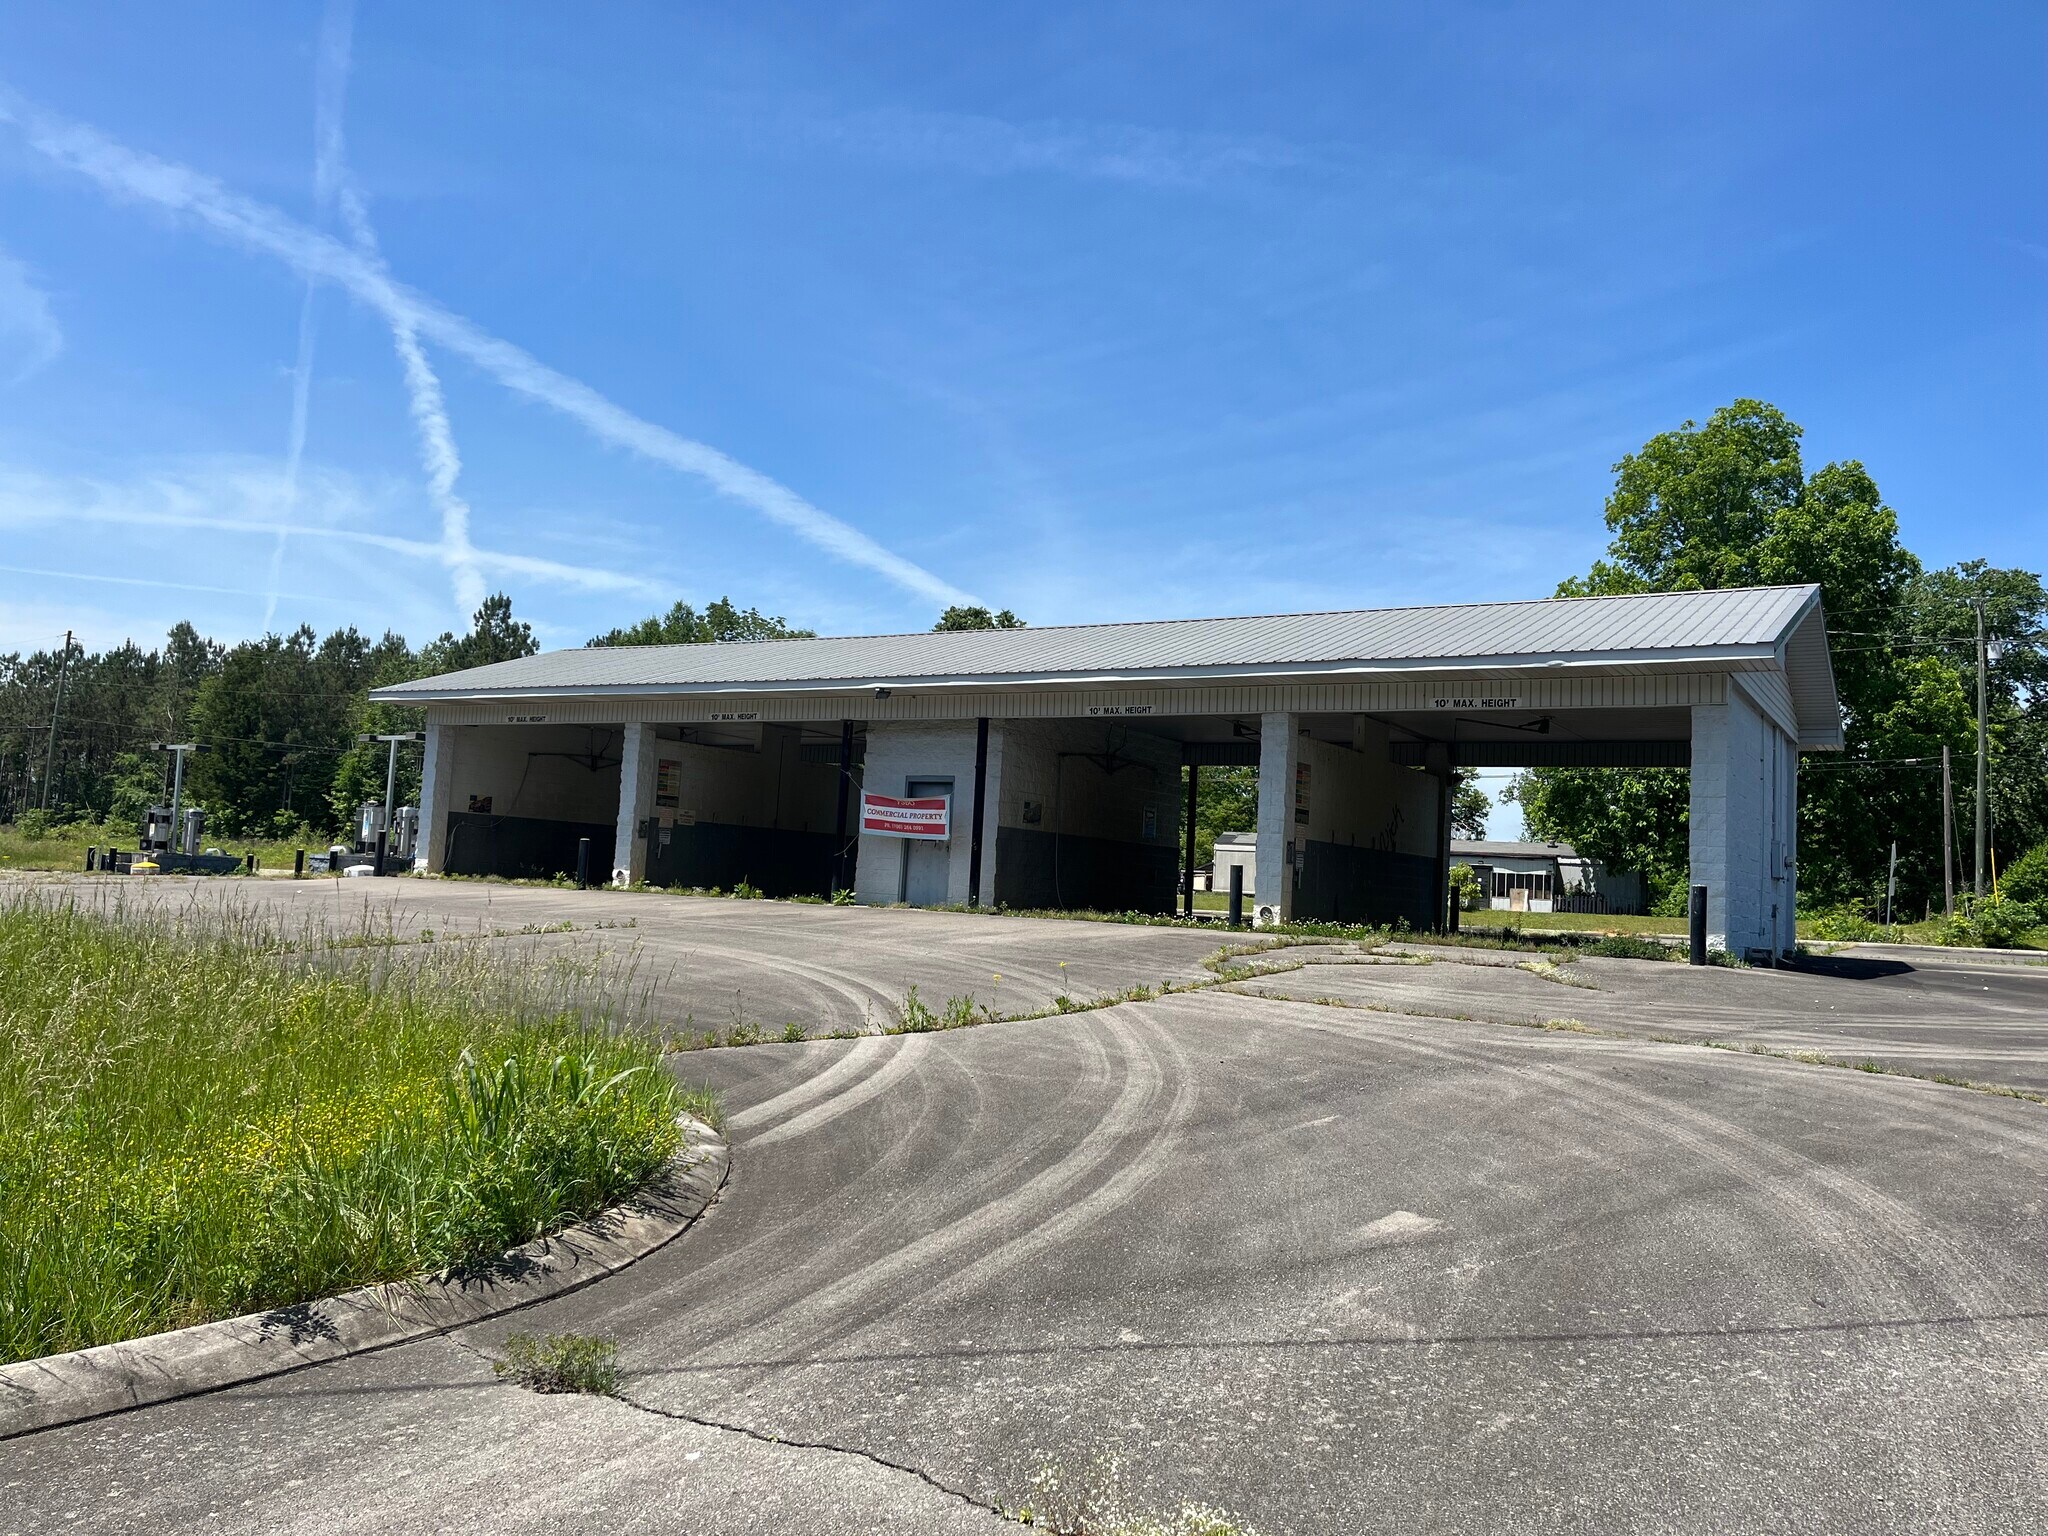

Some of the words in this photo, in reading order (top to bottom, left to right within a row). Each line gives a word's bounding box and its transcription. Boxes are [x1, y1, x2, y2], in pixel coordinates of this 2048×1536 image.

[1434, 699, 1449, 708] 10'
[1453, 699, 1477, 708] MAX.
[1481, 699, 1517, 708] HEIGHT
[1089, 707, 1101, 715] 10'
[1103, 707, 1122, 715] MAX.
[1125, 706, 1152, 714] HEIGHT
[867, 808, 908, 819] COMMERCIAL
